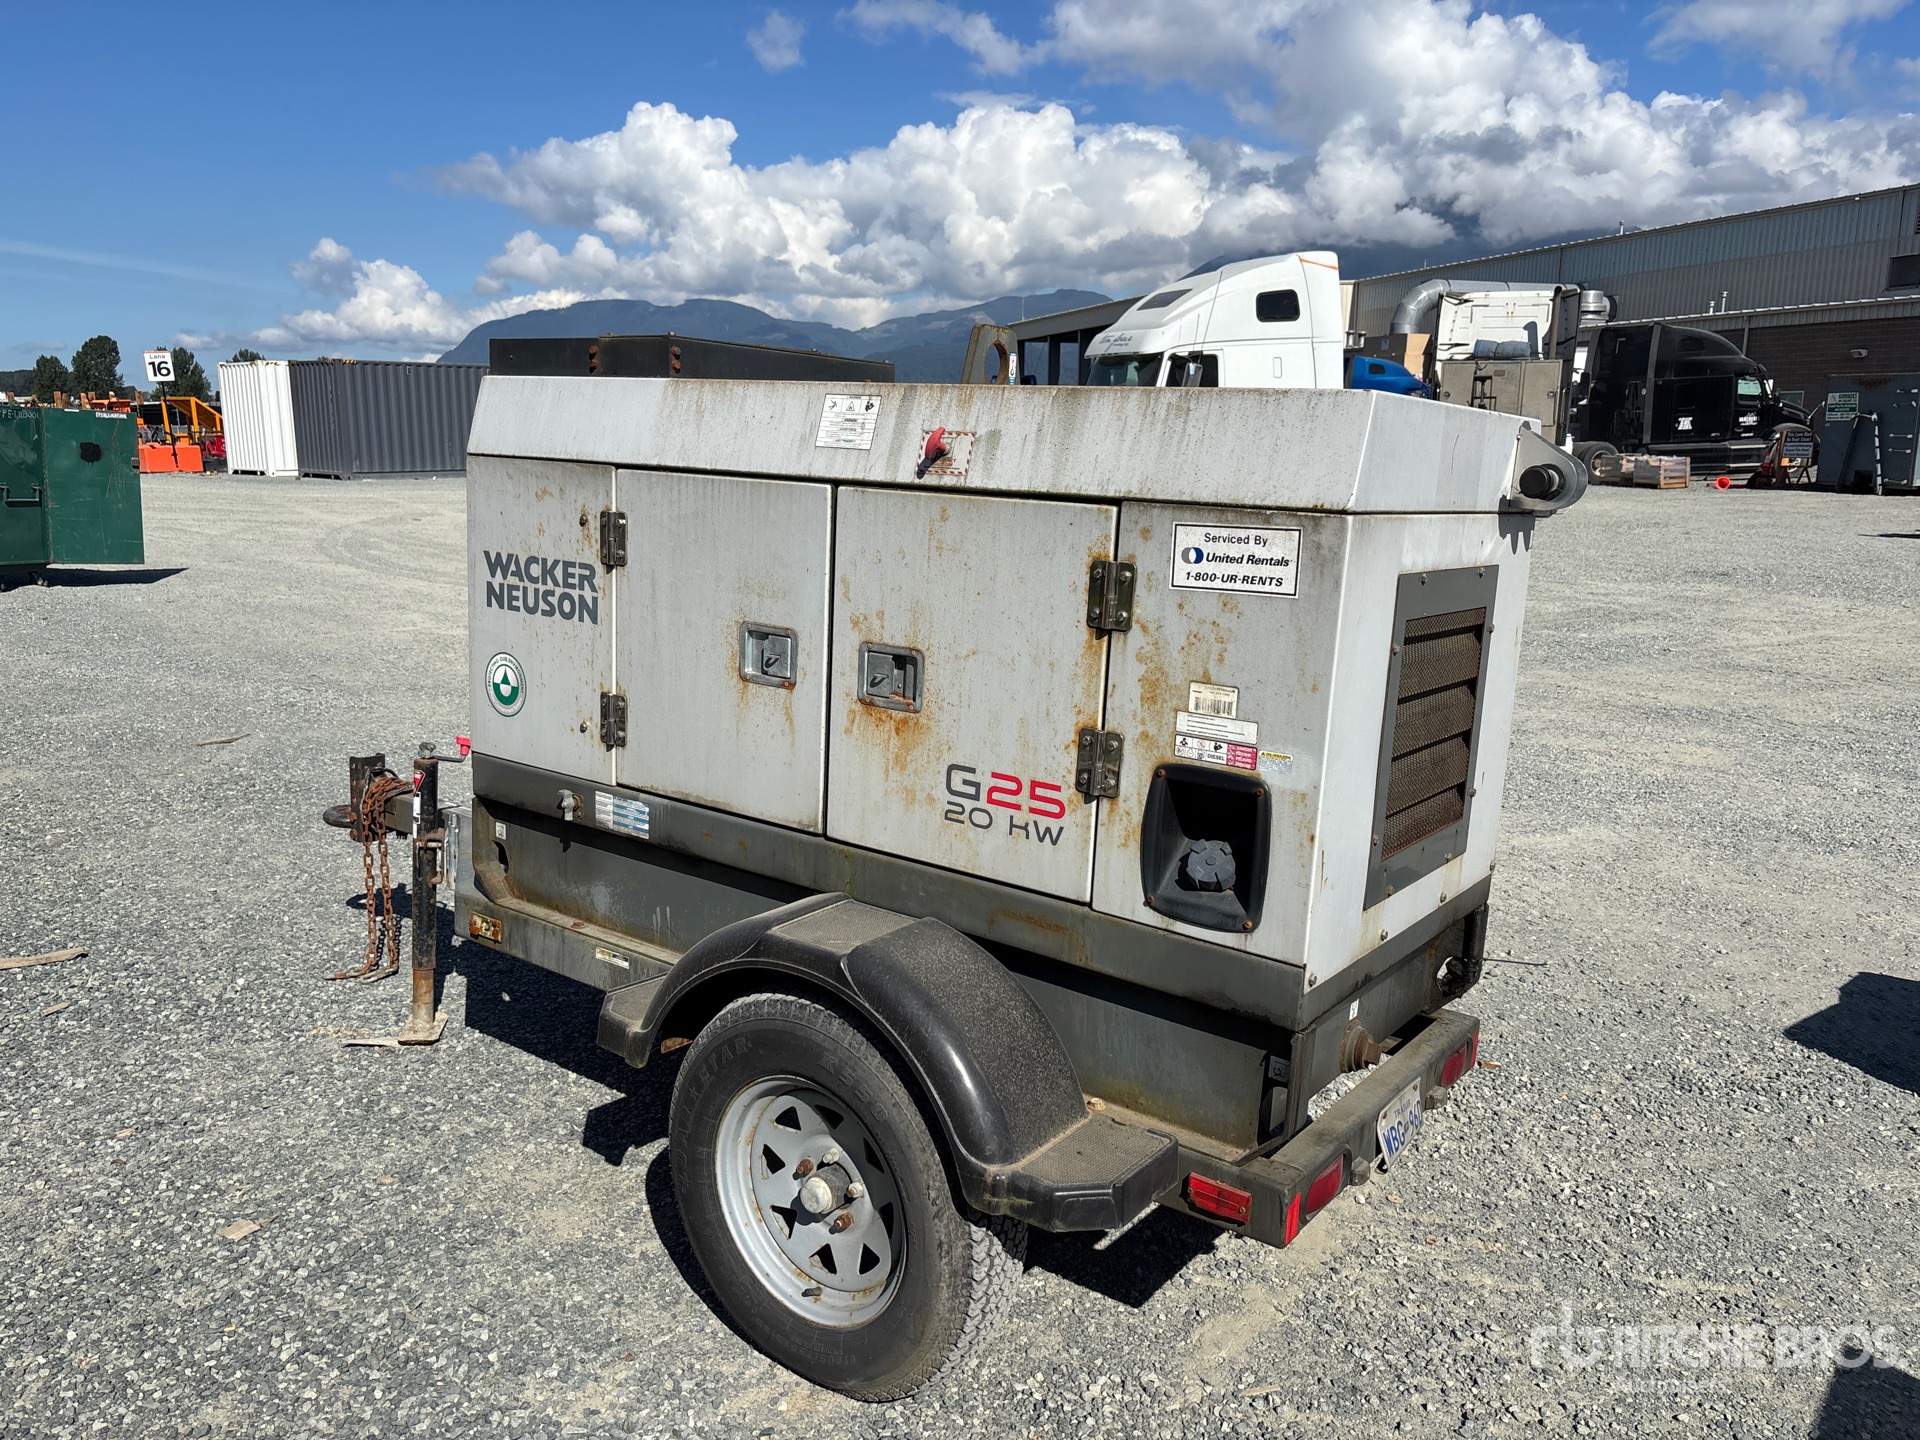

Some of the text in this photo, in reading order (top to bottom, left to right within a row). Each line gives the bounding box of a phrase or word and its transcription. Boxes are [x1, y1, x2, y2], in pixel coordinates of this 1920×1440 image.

[147, 360, 172, 377] 16
[1204, 533, 1269, 547] Serviced By
[1206, 552, 1290, 567] United Rentals
[483, 550, 599, 593] WACKER
[1185, 571, 1284, 587] 1-800-UR-RENTS
[486, 581, 599, 625] NEUSON
[1207, 753, 1226, 762] DIESEL
[945, 763, 1066, 820] G25
[944, 800, 993, 830] 20
